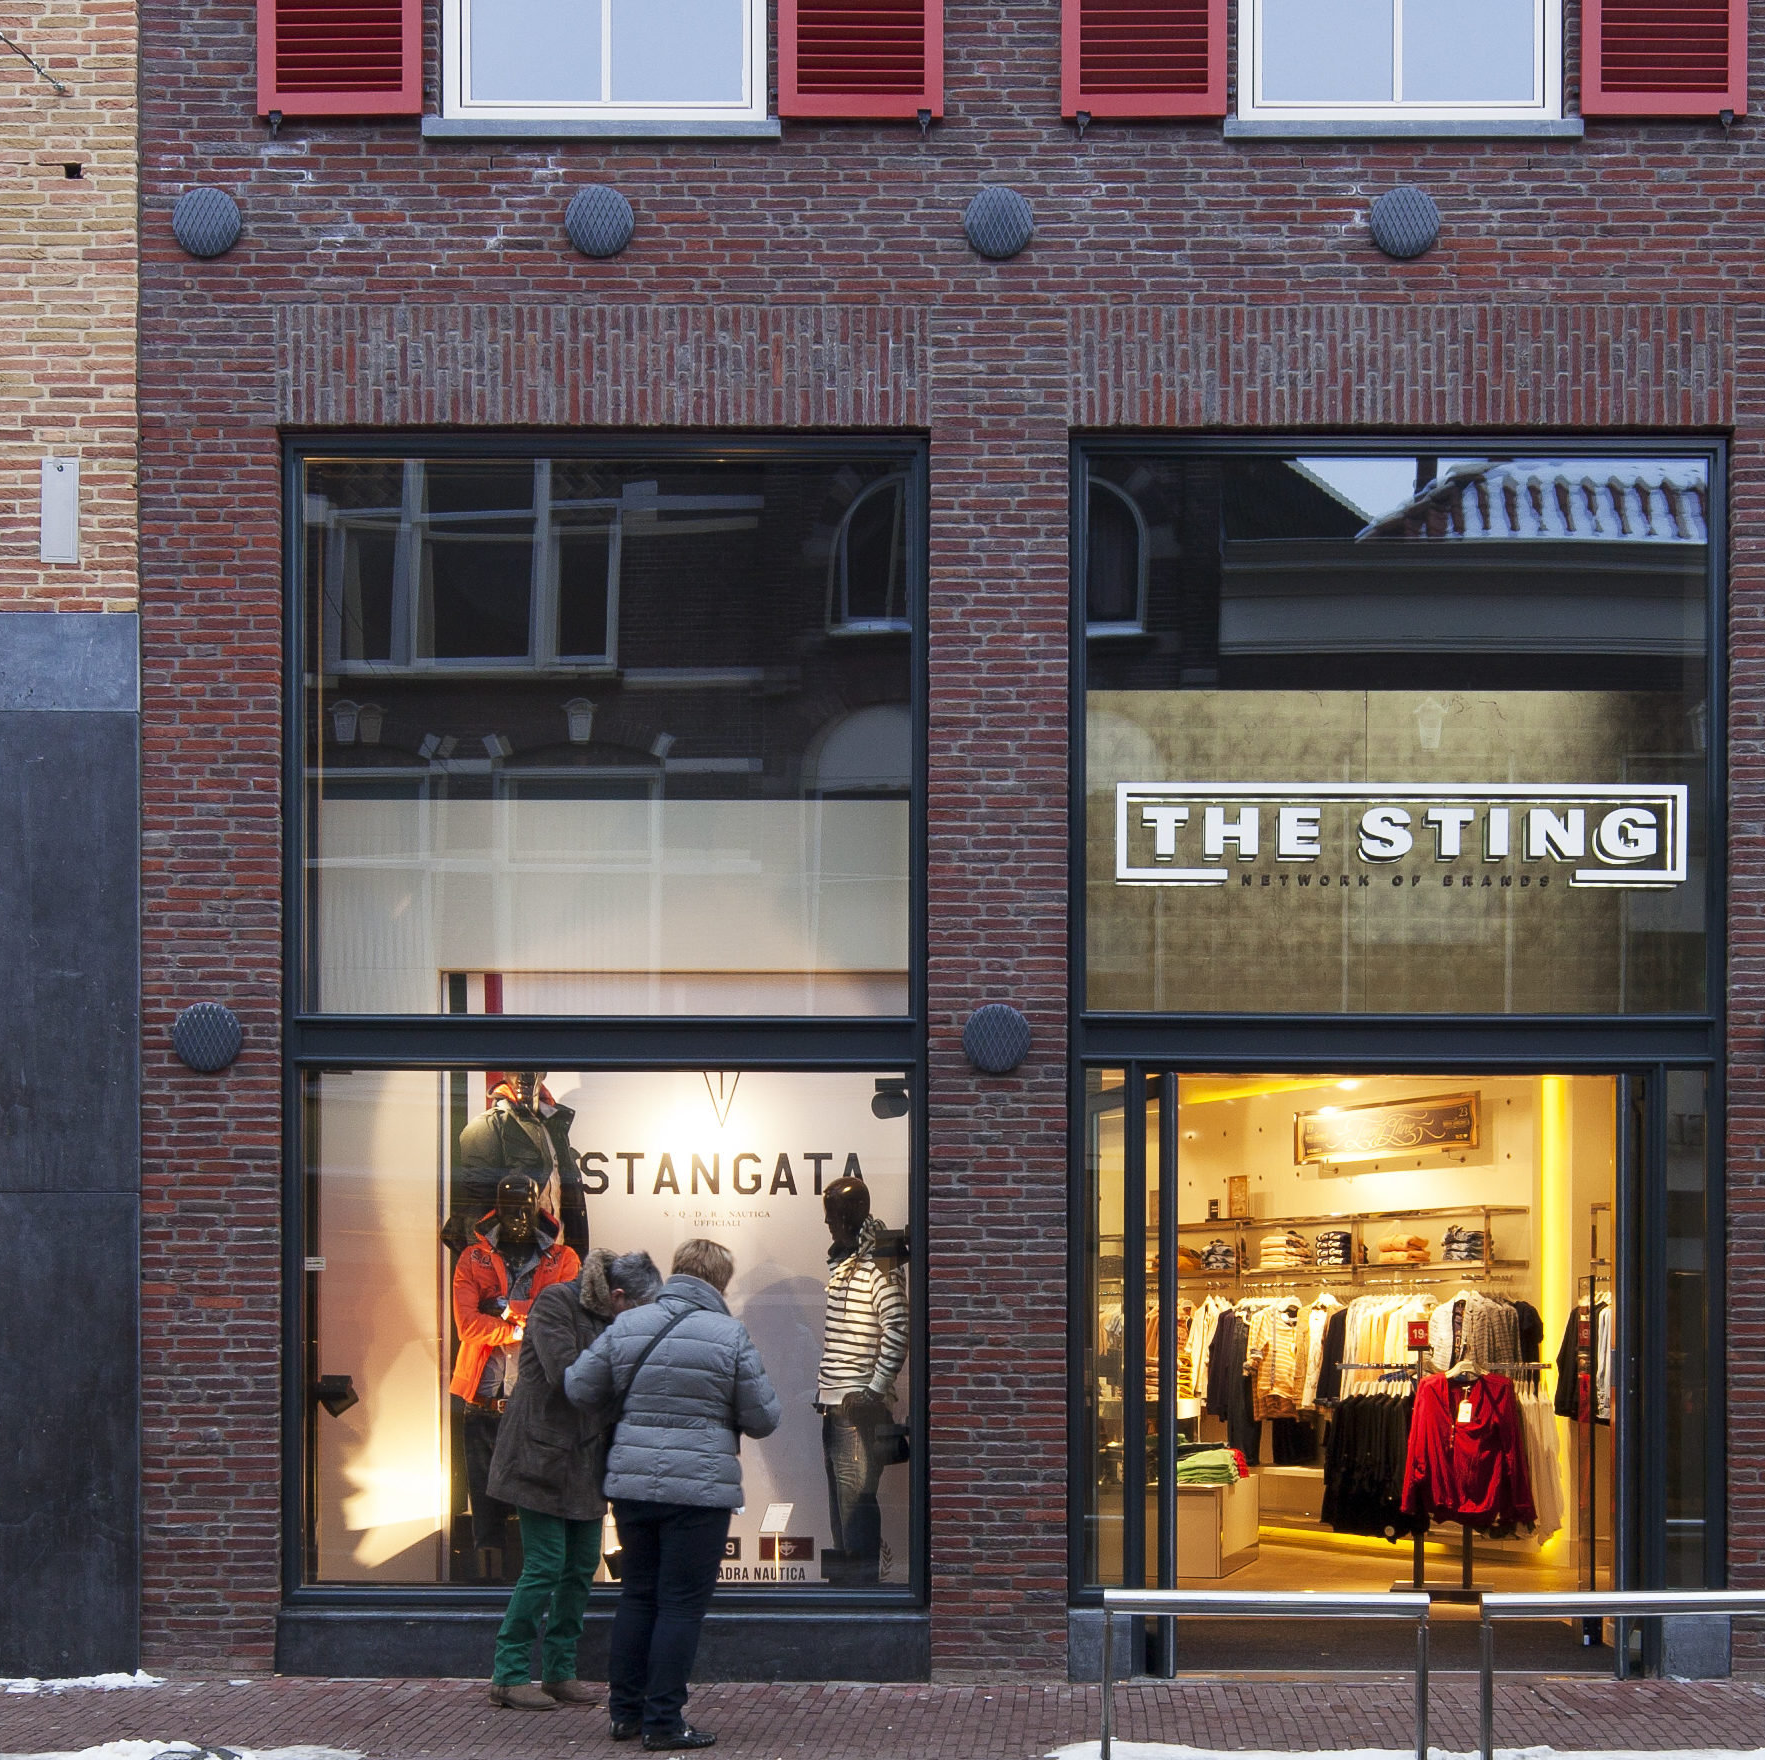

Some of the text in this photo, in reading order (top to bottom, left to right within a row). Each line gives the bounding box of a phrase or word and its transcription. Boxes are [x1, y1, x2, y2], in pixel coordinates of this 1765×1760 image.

[1141, 806, 1658, 862] THE STING
[1240, 873, 1550, 887] NETWORK OF BRANDS
[580, 1152, 865, 1196] STANGATA
[729, 1210, 771, 1218] NAUTICA
[717, 1566, 806, 1581] ADRA NAUTICA
